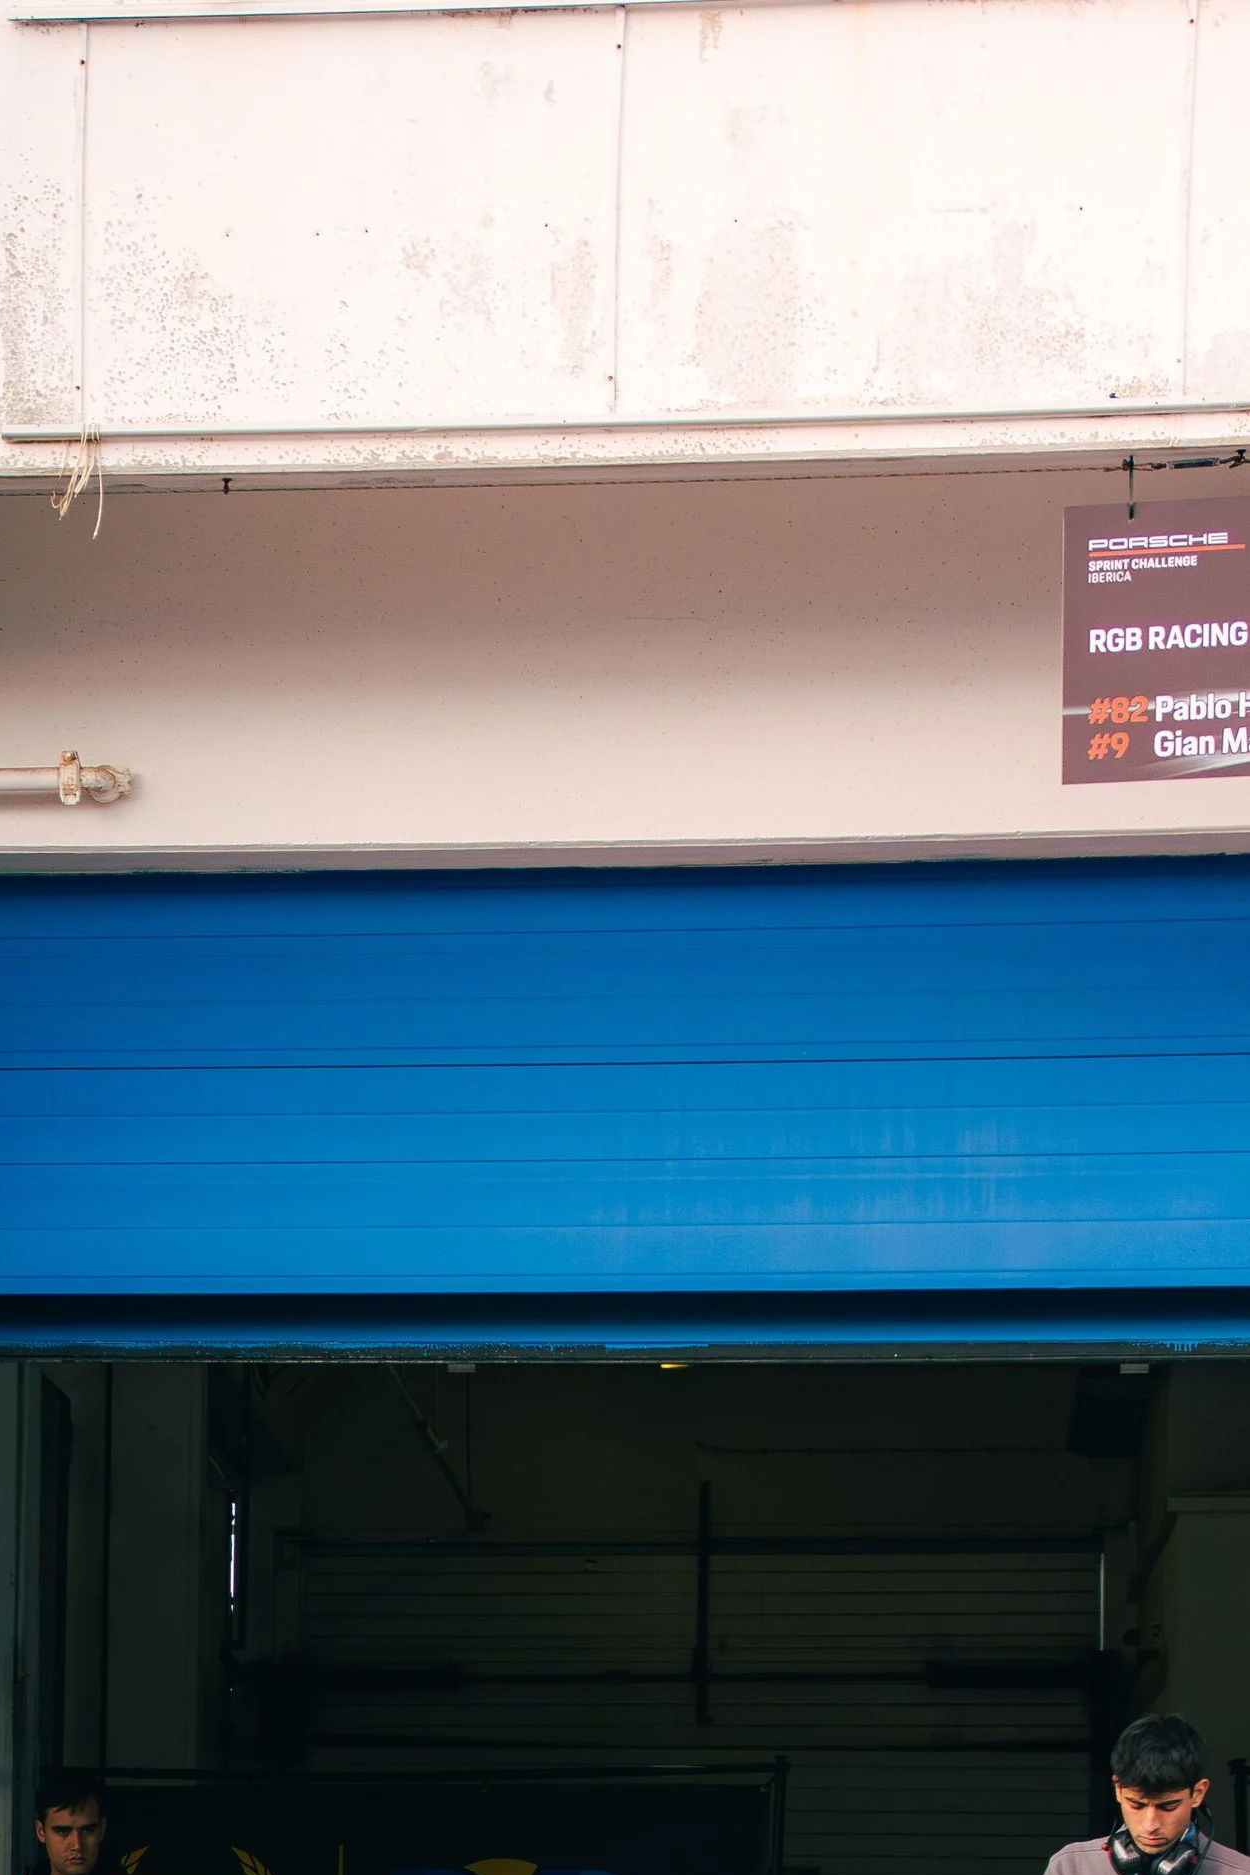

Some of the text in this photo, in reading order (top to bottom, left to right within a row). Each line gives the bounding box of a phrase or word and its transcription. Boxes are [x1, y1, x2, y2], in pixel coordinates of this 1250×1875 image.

[1088, 532, 1229, 552] PORSCHE
[1088, 555, 1198, 571] SPRINT CHALLENGE
[1088, 570, 1132, 584] IBERICA
[1089, 621, 1249, 653] RGB RACING
[1088, 695, 1149, 724] #82
[1154, 692, 1231, 722] Pablo
[1087, 731, 1130, 760] #9
[1153, 730, 1216, 757] Gian
